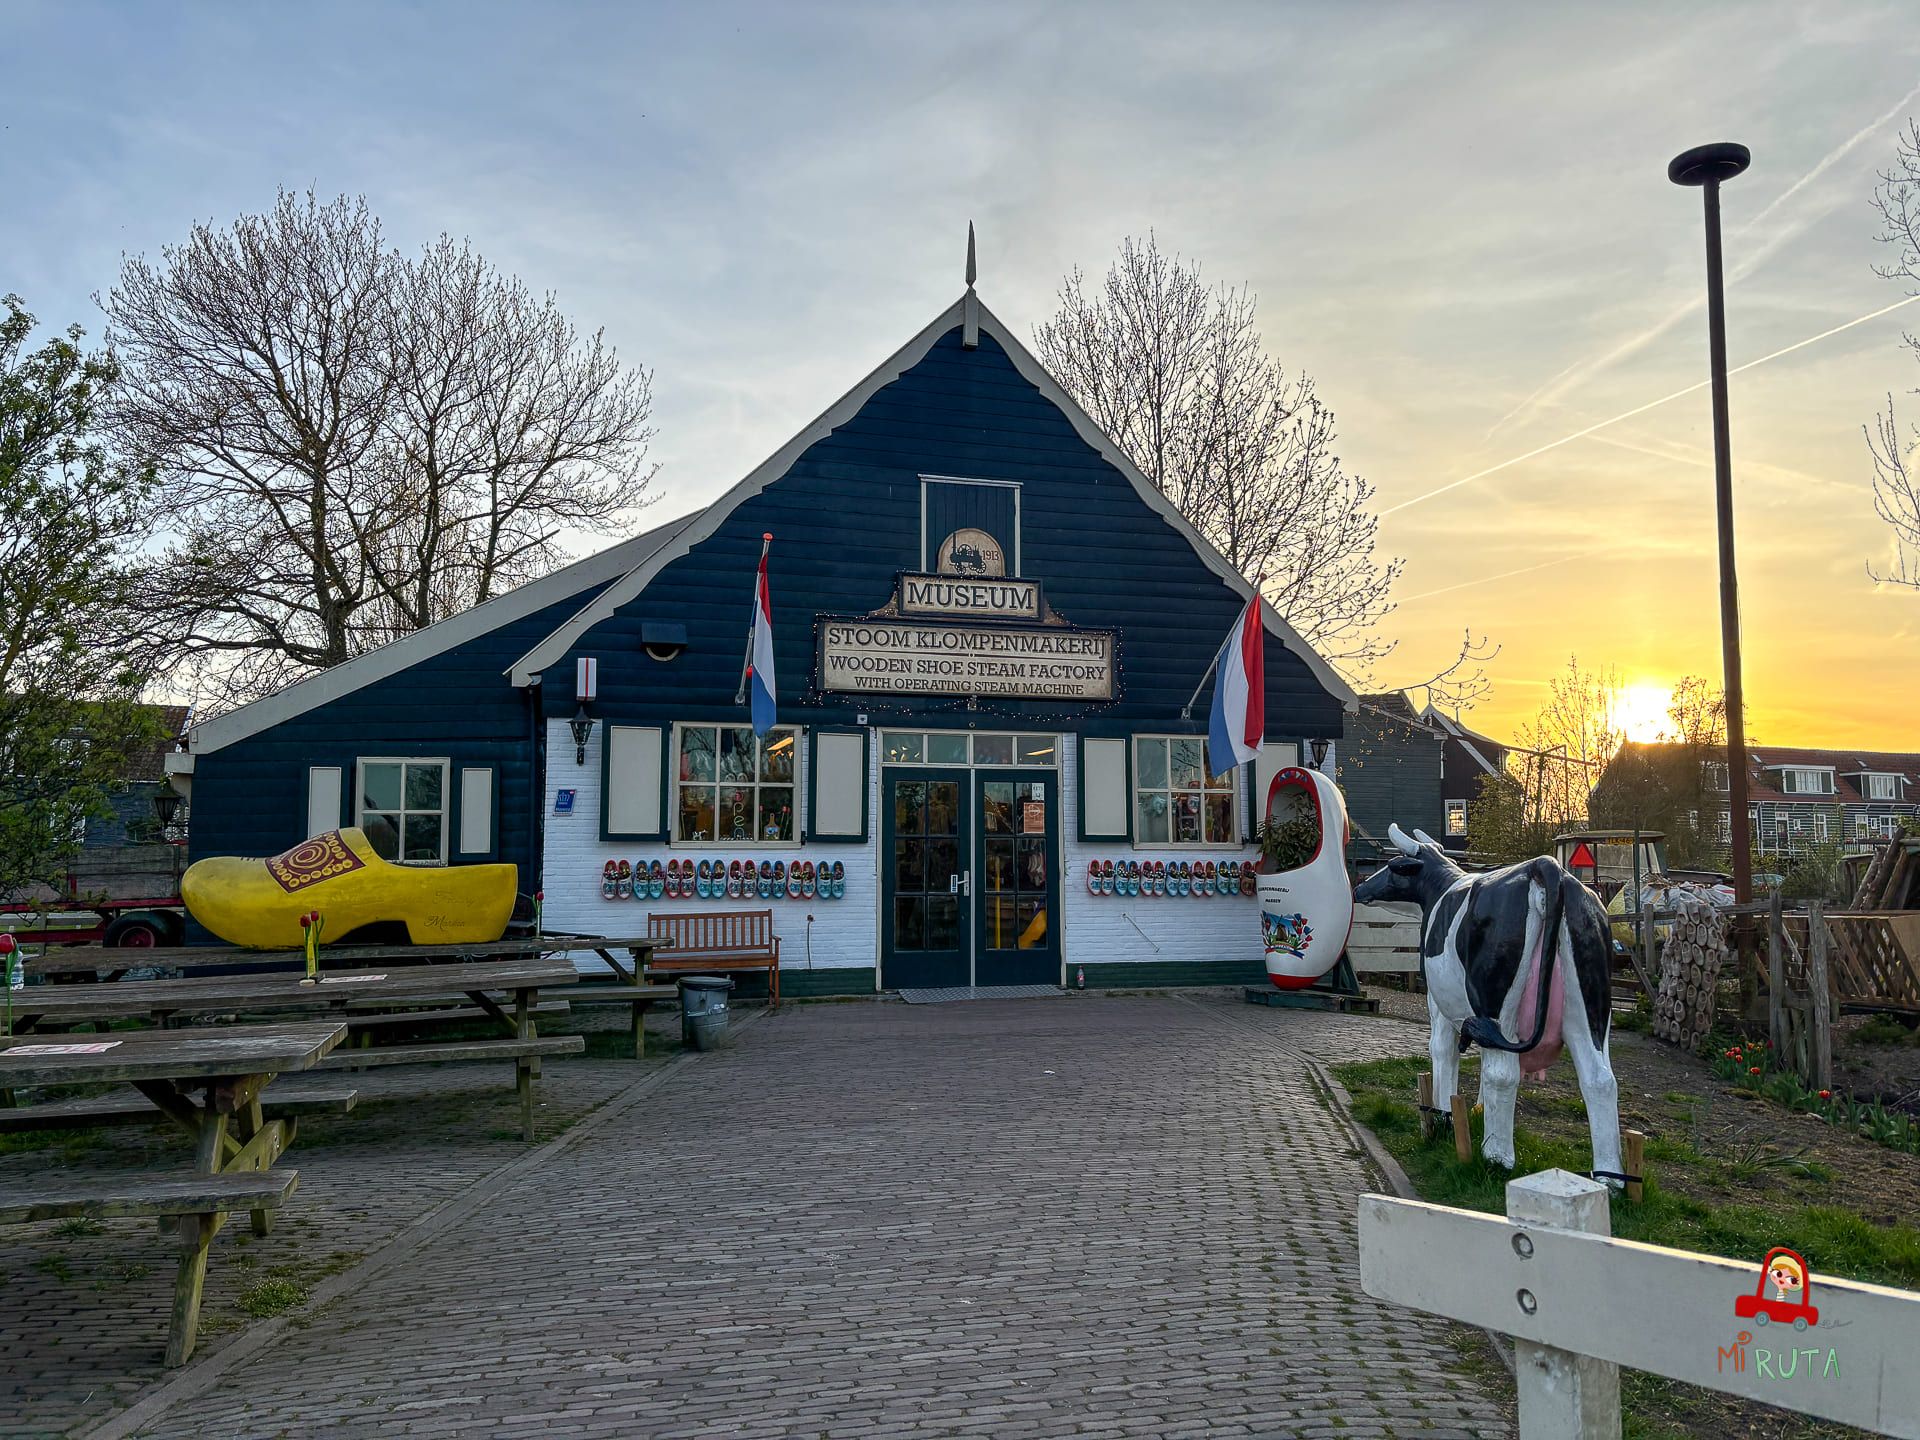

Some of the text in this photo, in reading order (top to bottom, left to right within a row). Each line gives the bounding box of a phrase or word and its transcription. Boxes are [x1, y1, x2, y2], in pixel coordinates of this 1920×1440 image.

[982, 549, 999, 561] 1913
[907, 582, 1034, 610] MUSEUM
[829, 627, 1107, 659] STOOM KLOMPENMAKERIJ
[829, 655, 1107, 680] WOODEN SHOE STEAM FACTORY
[855, 676, 1084, 695] WITH OPERATING STEAM MACHINE
